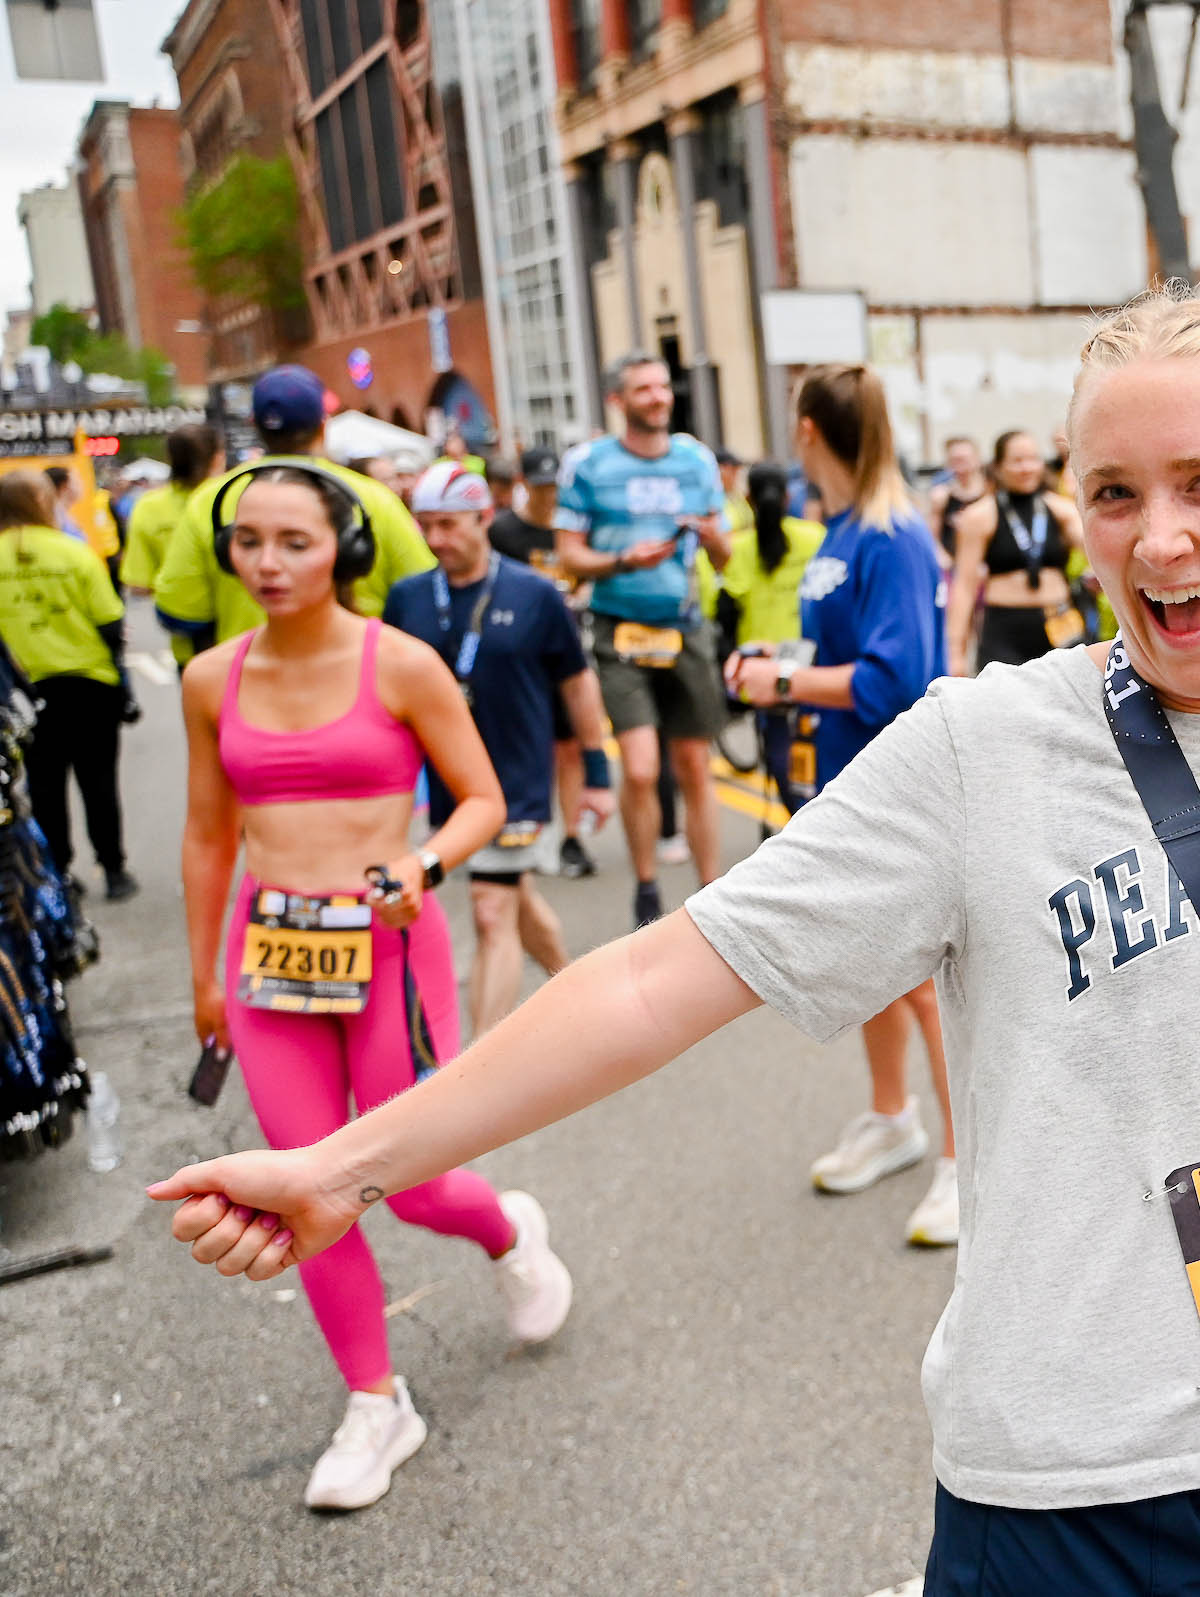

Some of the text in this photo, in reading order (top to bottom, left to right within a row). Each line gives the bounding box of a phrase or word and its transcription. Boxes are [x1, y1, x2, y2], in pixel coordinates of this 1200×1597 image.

[46, 406, 206, 437] MARATHON
[1104, 628, 1141, 711] 3.1
[258, 940, 358, 975] 22307
